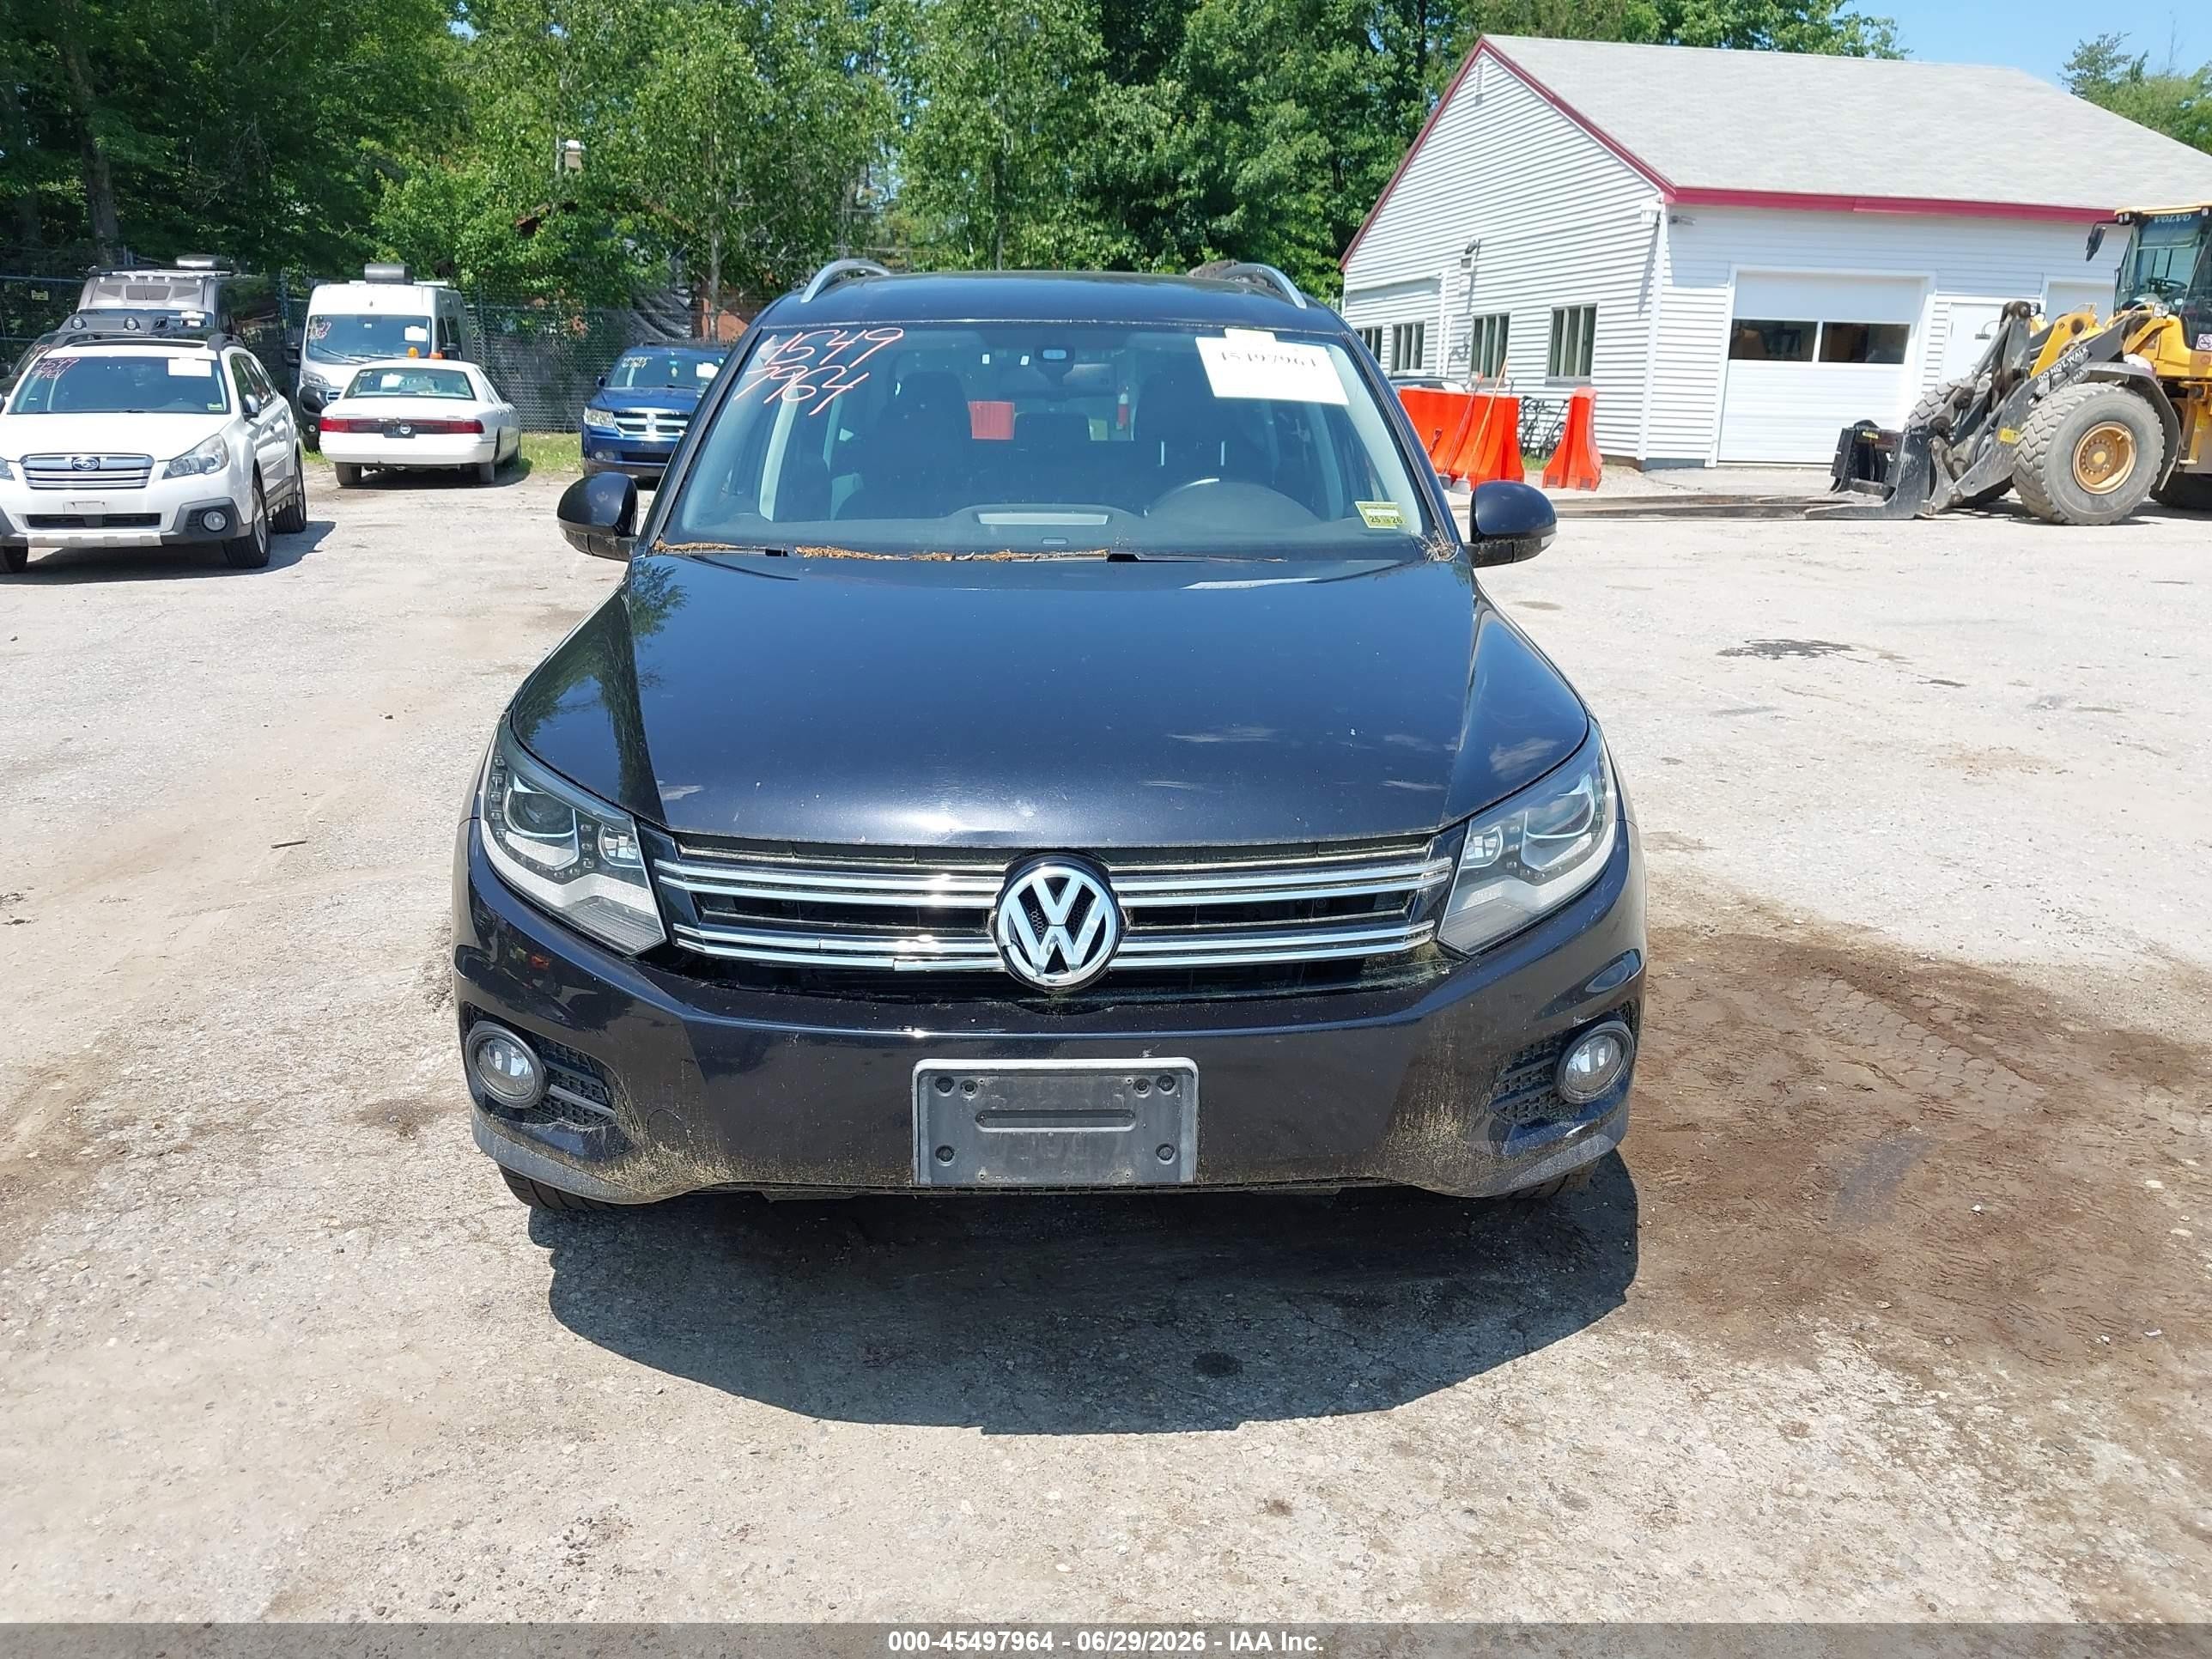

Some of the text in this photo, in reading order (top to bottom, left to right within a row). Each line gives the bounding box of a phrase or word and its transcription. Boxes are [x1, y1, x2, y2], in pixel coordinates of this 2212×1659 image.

[2154, 213, 2192, 223] VOLVO
[2037, 371, 2049, 384] DO
[2050, 359, 2069, 375] NOT
[2066, 344, 2089, 365] WALK
[733, 365, 870, 416] 7964
